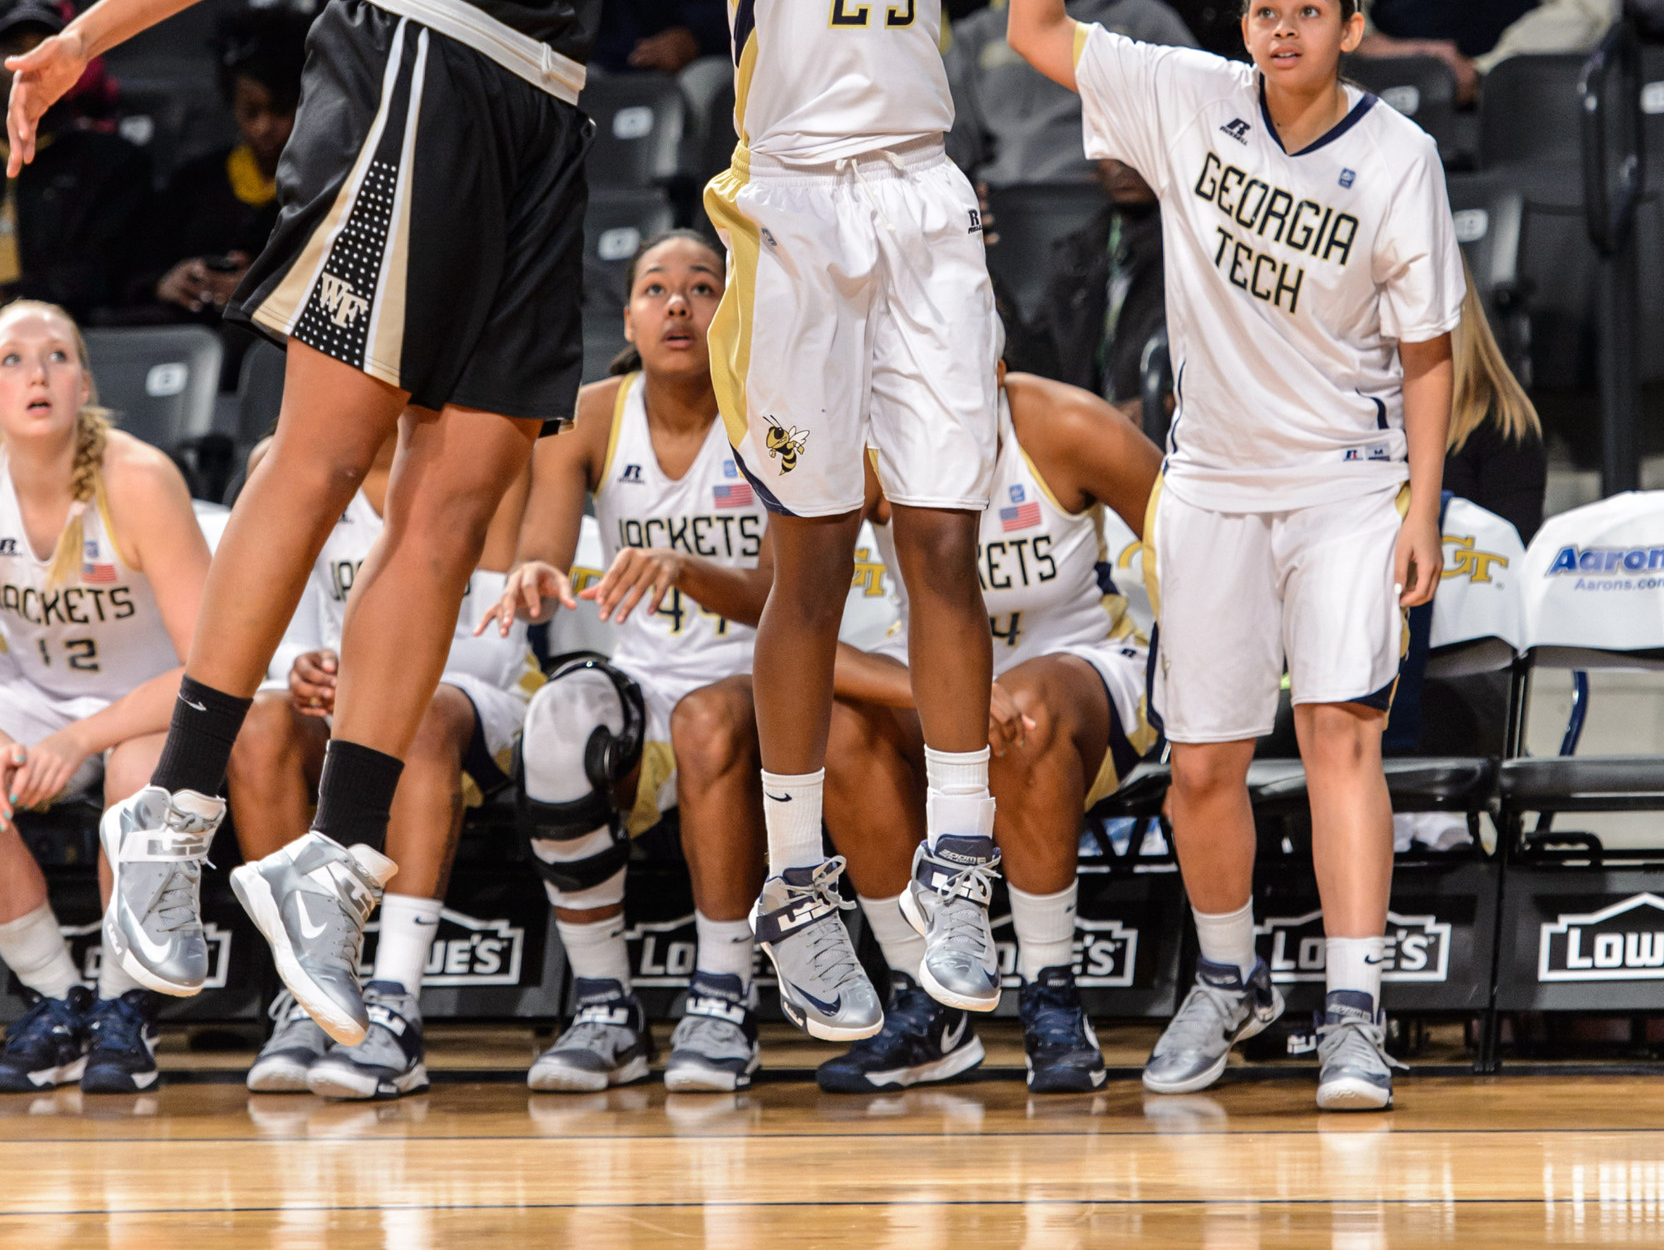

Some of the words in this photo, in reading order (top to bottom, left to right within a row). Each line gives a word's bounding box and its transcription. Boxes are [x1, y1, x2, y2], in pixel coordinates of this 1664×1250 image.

[1194, 151, 1360, 266] GEORGIA
[1214, 225, 1305, 314] TECH
[0, 584, 135, 626] ACKETS
[38, 638, 100, 673] 12
